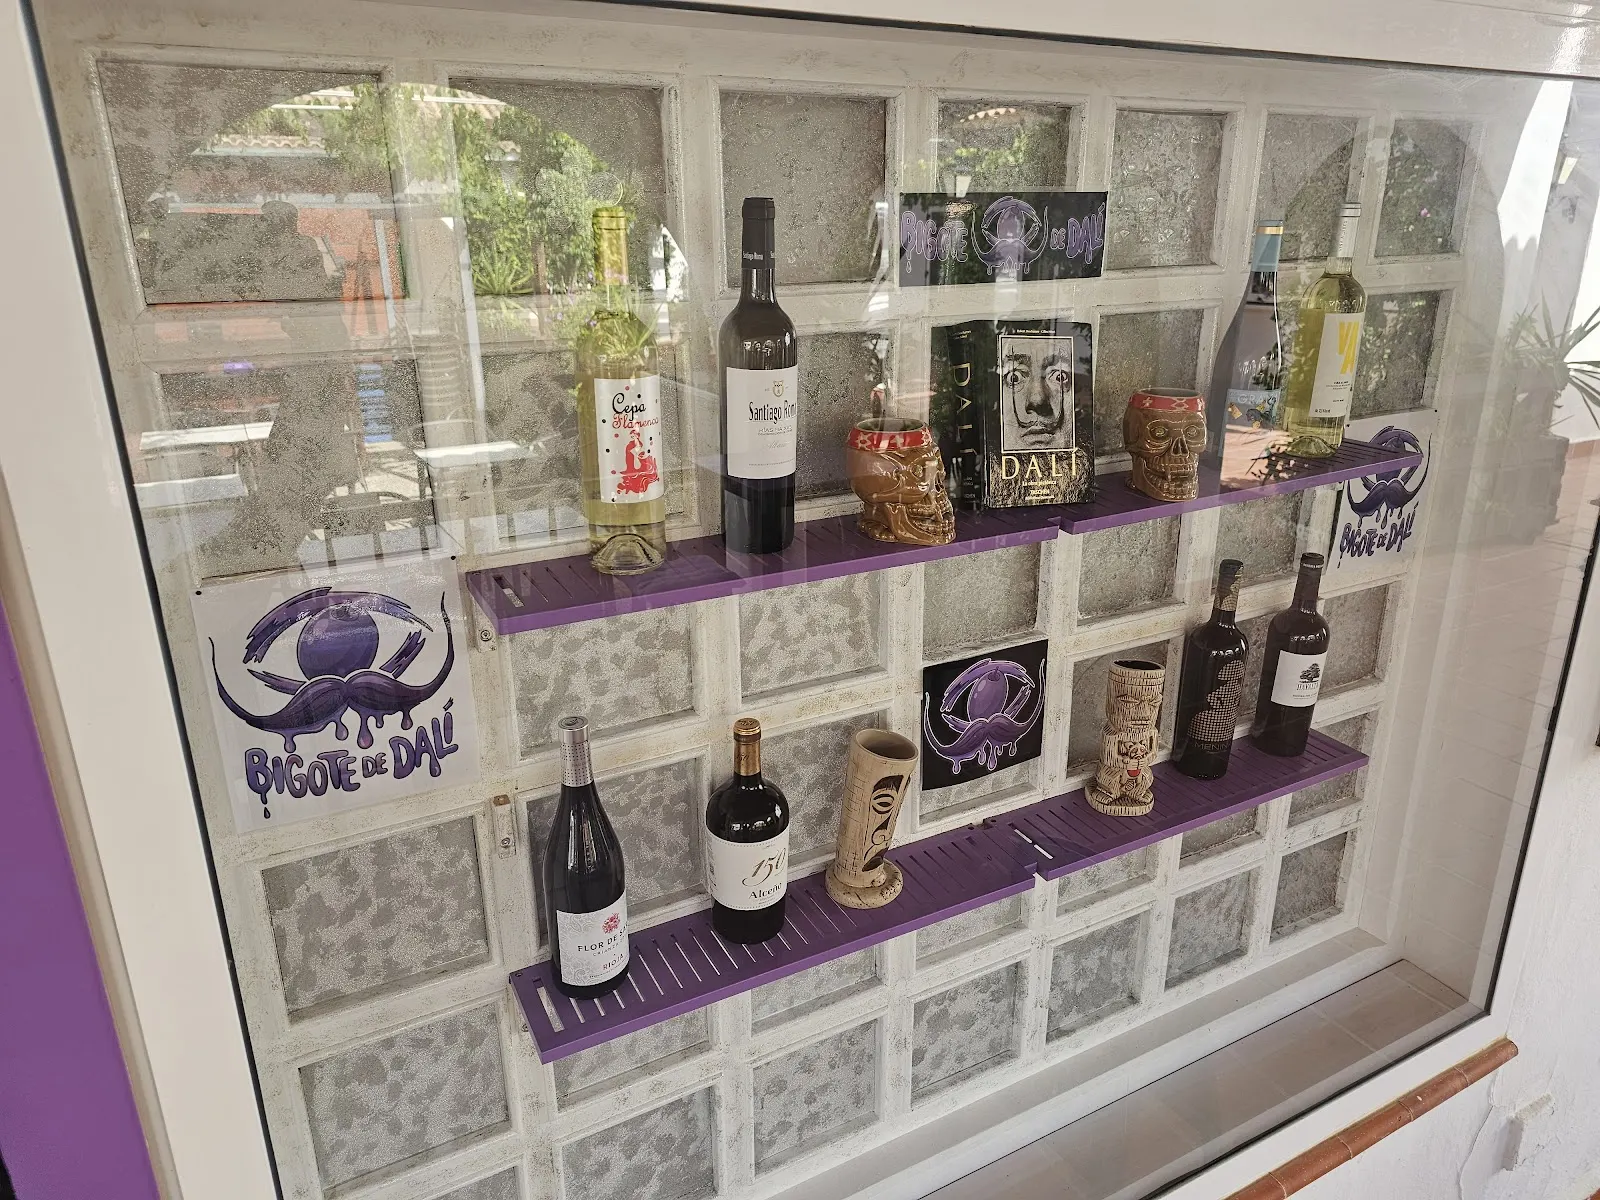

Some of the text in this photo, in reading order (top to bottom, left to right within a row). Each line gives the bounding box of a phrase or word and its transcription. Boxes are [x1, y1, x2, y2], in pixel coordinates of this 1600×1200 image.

[901, 202, 1105, 264] BIGOTE DE DALÍ
[612, 393, 646, 421] Cepa
[748, 401, 782, 424] Santiago
[1001, 447, 1078, 480] DALÍ
[1340, 522, 1379, 557] BIGOTE
[1377, 532, 1388, 549] DE
[245, 697, 459, 804] BIGOTE DE DALÍ
[742, 847, 786, 887] 150
[577, 941, 604, 952] FLOR
[607, 934, 618, 945] DE
[602, 953, 624, 970] RIOJA
